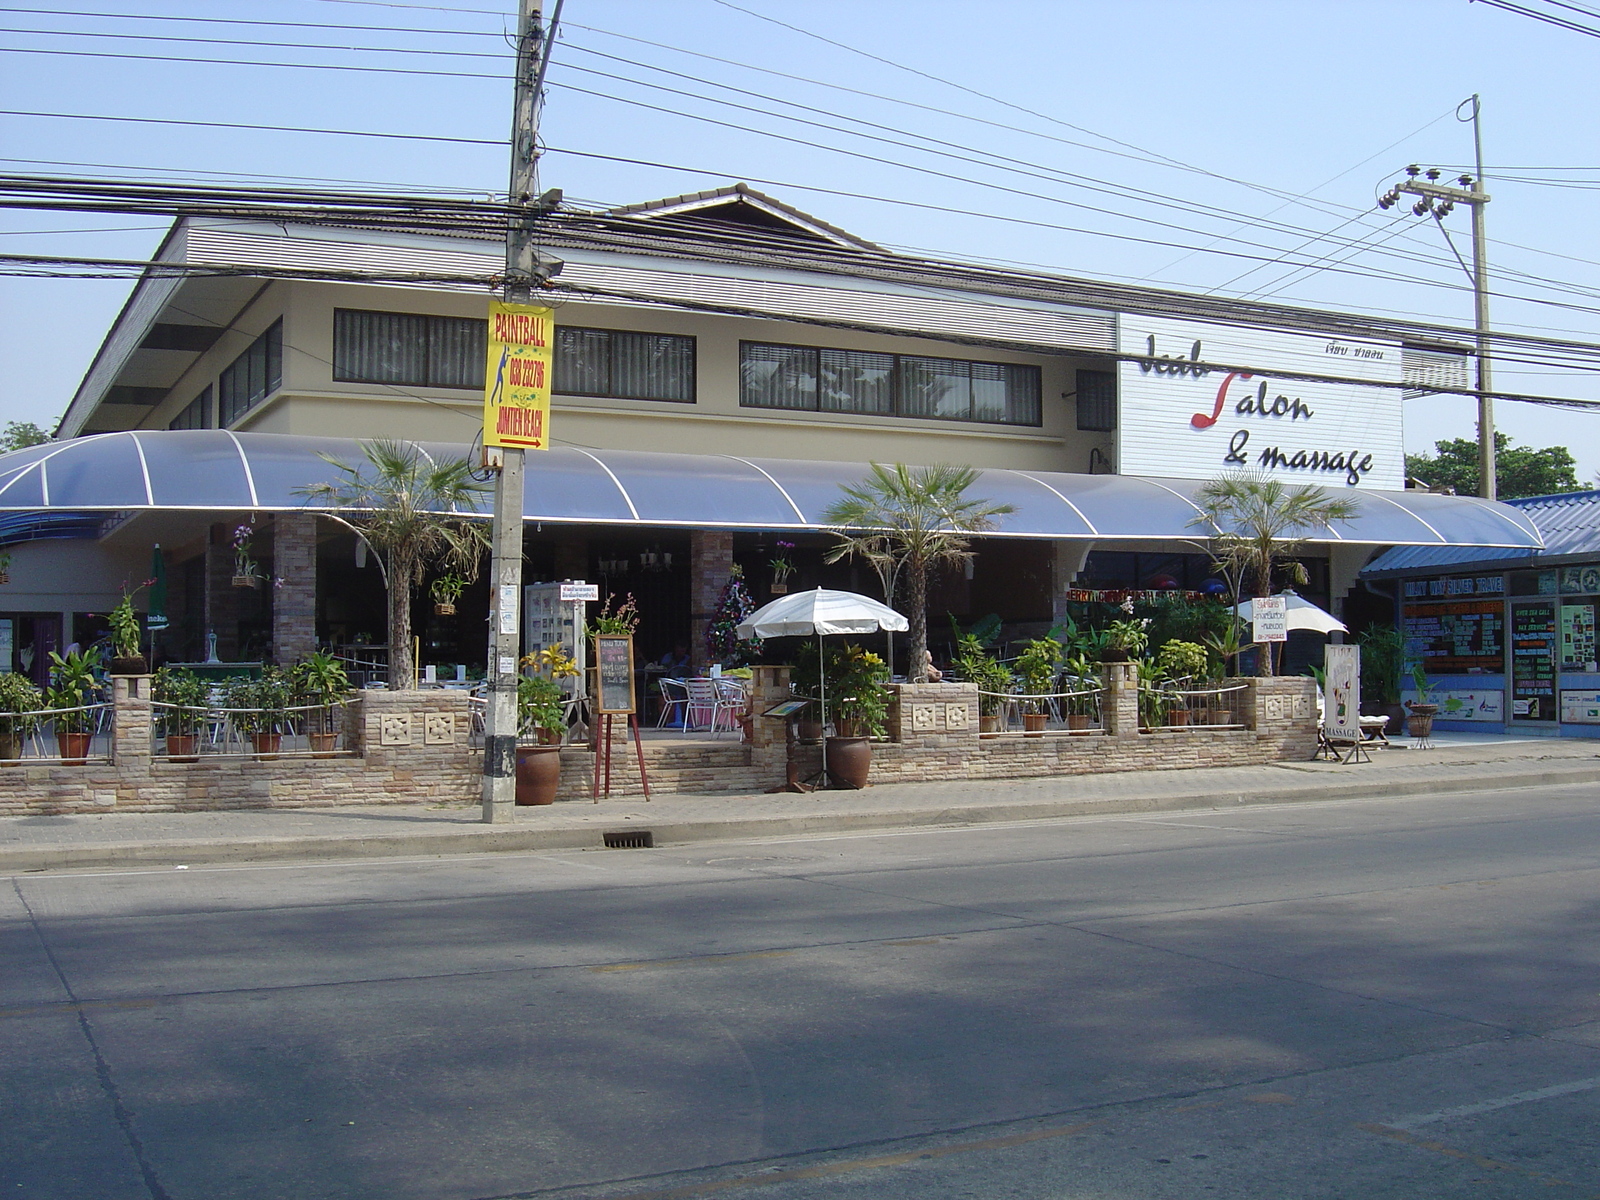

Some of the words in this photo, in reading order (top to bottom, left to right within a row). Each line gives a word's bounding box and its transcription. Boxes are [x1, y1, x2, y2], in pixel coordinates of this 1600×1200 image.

[495, 313, 546, 347] PAINTBALL
[509, 357, 522, 386] 038
[496, 406, 523, 436] JOMTIEN
[523, 408, 543, 438] BEACH
[1223, 429, 1250, 465] &
[1258, 444, 1374, 486] massage
[1405, 581, 1427, 597] MILKY
[1429, 580, 1445, 596] WAY
[1447, 578, 1474, 595] SILVER
[1325, 728, 1357, 738] MASSAGE
